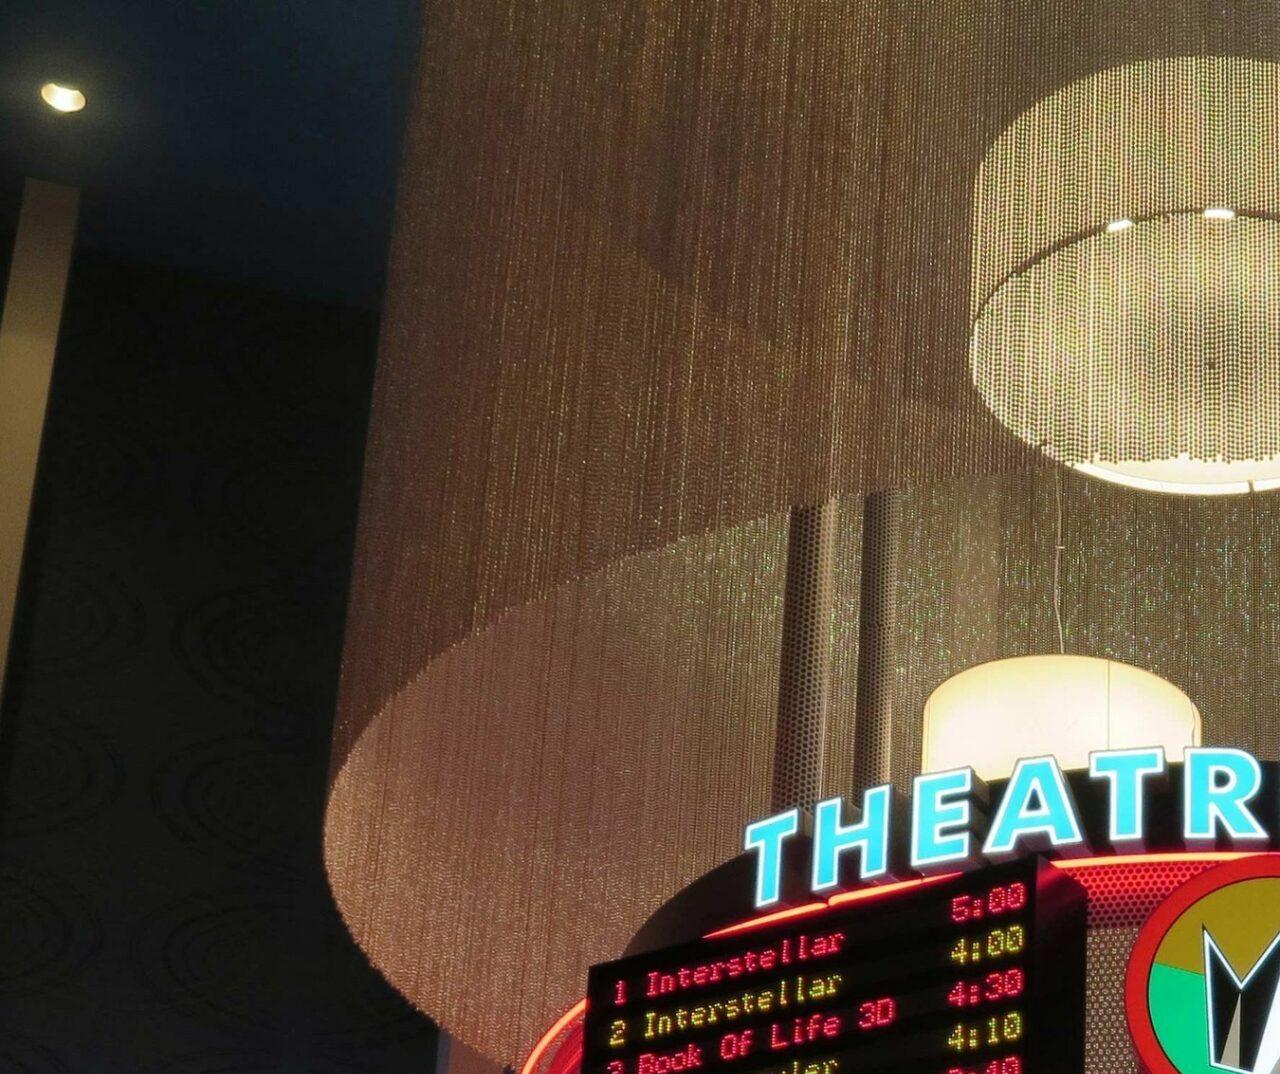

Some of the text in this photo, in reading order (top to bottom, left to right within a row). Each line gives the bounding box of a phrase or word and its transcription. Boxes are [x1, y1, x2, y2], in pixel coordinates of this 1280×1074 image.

[610, 926, 1023, 1045] 2 Interstellar 4:00
[615, 883, 1026, 1004] 1 Interstellar 5:00
[720, 1030, 752, 1060] Of
[771, 1014, 839, 1048] Life
[859, 998, 895, 1028] 3D
[948, 969, 1023, 1006] 4:30
[948, 1013, 1020, 1049] 4:10
